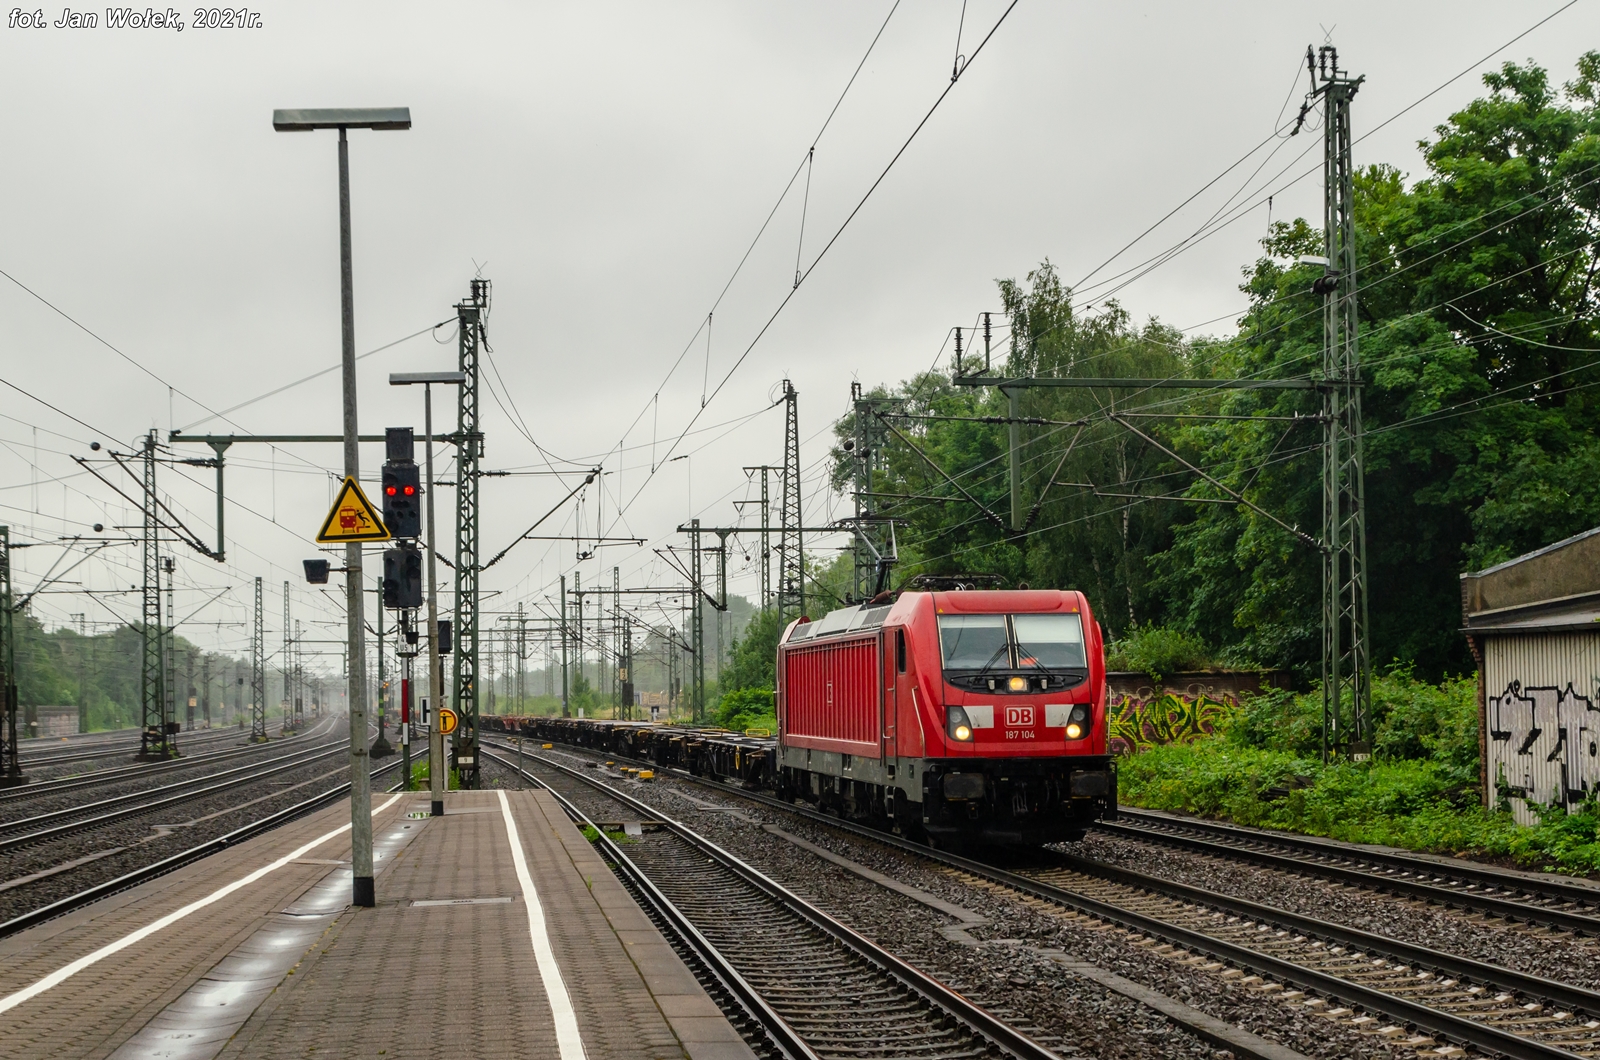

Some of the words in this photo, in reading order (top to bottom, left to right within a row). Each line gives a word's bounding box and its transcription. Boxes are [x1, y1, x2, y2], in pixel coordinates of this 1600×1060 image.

[1008, 708, 1032, 724] DB
[1005, 730, 1019, 739] 187
[1021, 730, 1035, 739] 104
